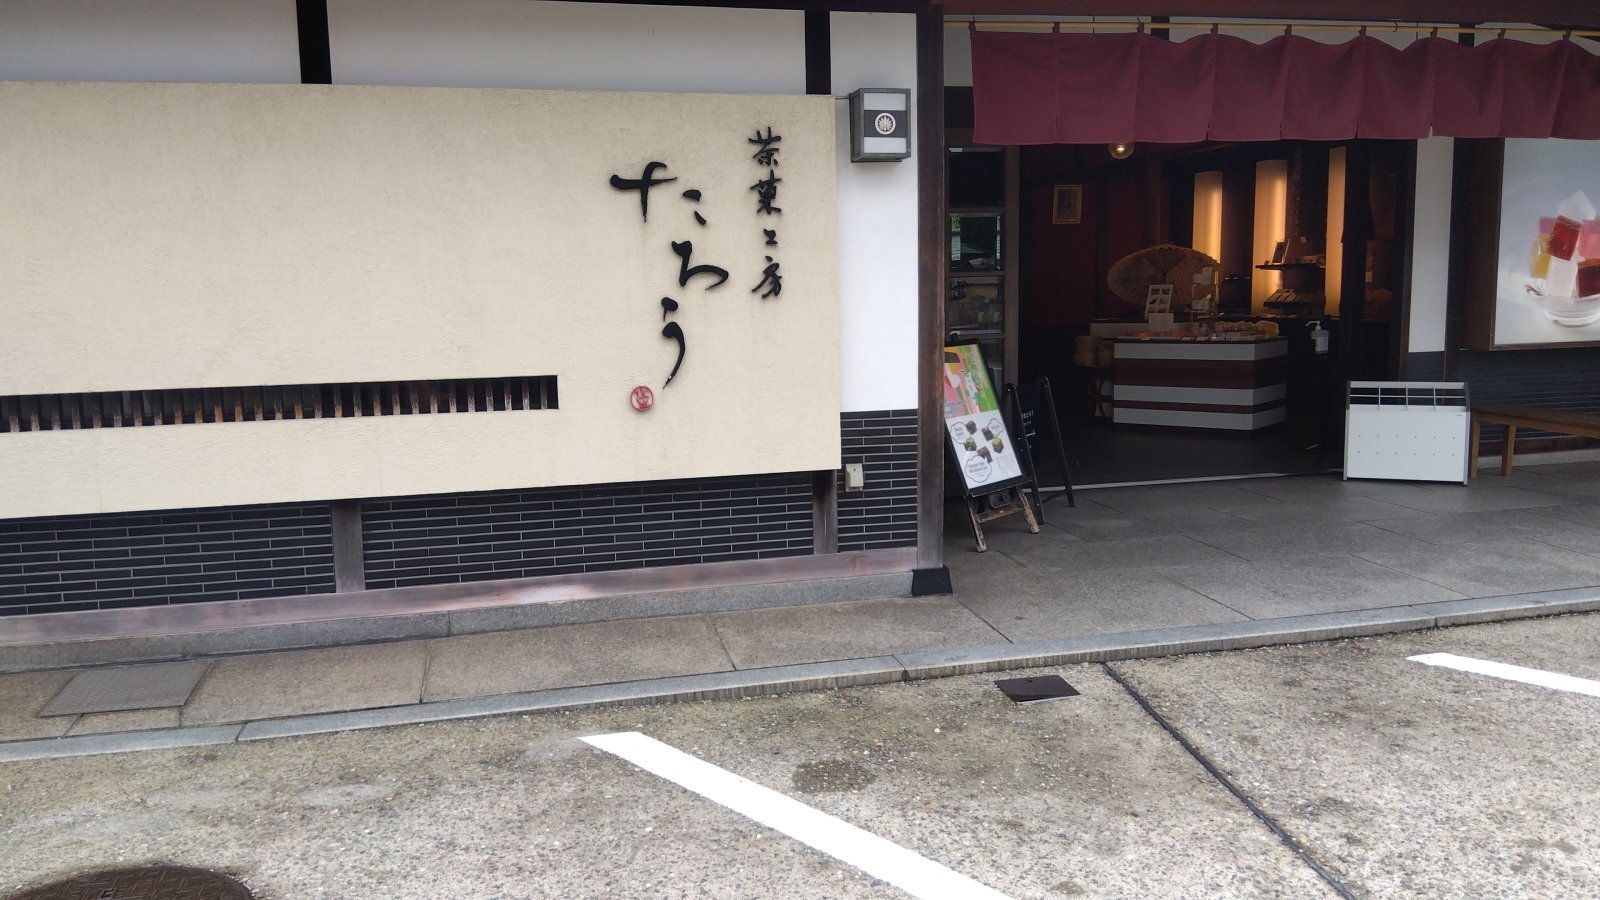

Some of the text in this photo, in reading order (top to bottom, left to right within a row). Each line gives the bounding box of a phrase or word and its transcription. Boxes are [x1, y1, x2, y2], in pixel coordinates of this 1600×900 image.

[610, 162, 729, 390] たろう
[748, 127, 783, 299] 茶菓工房
